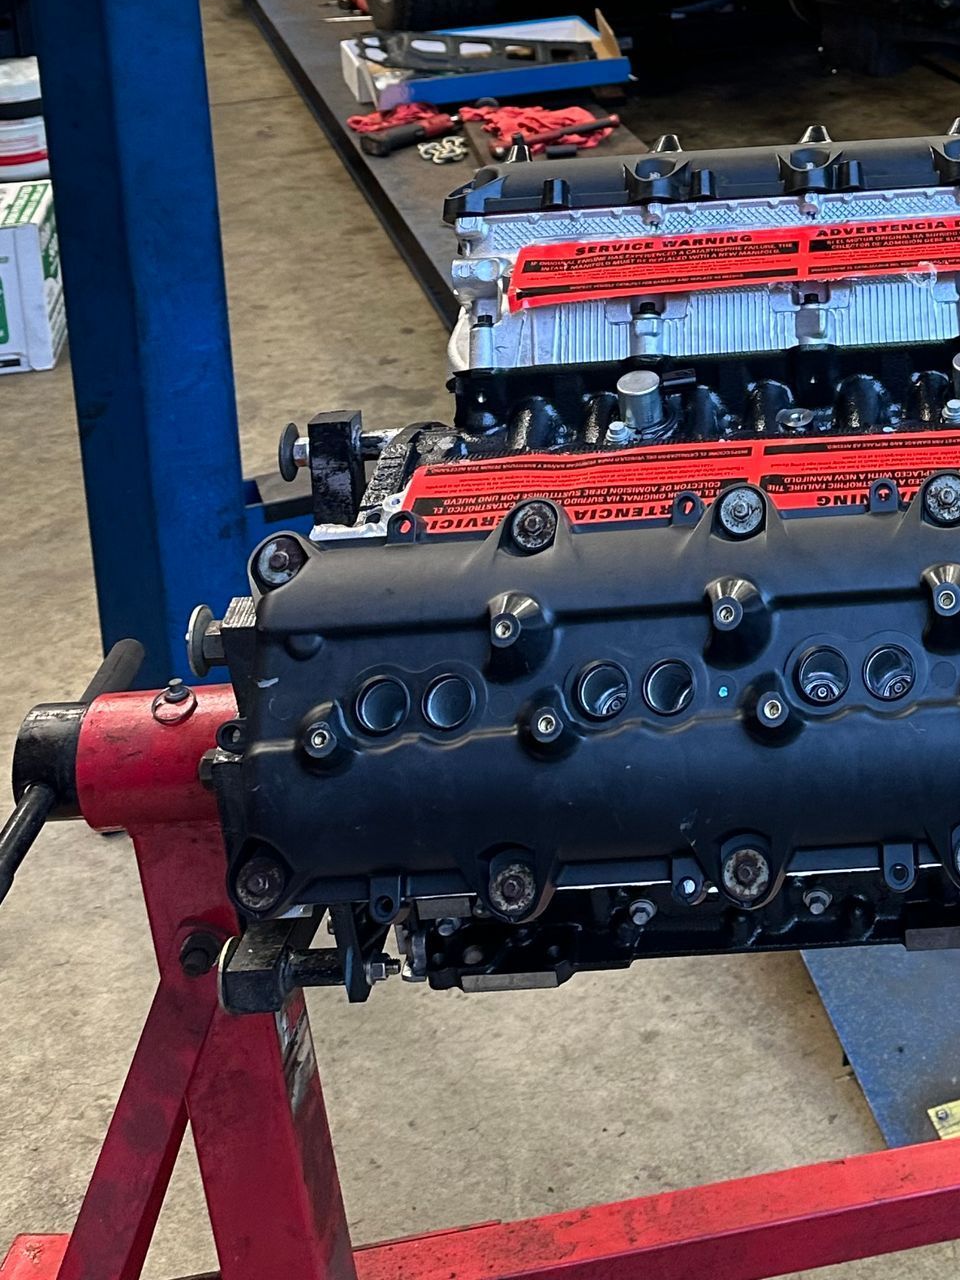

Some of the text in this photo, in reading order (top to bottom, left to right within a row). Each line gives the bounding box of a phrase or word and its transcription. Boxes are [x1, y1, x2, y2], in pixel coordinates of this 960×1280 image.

[816, 221, 947, 237] ADVERTENCIA
[575, 234, 752, 256] SERVICE WARNING
[833, 474, 857, 482] NEW
[867, 472, 893, 480] WITH
[673, 481, 721, 490] COLECTOR
[477, 495, 499, 503] UNO
[500, 493, 520, 501] POR
[522, 489, 581, 500] SUSTITUIRSE
[622, 493, 666, 502] ORIGINAL
[563, 496, 604, 505] SUFRIDO
